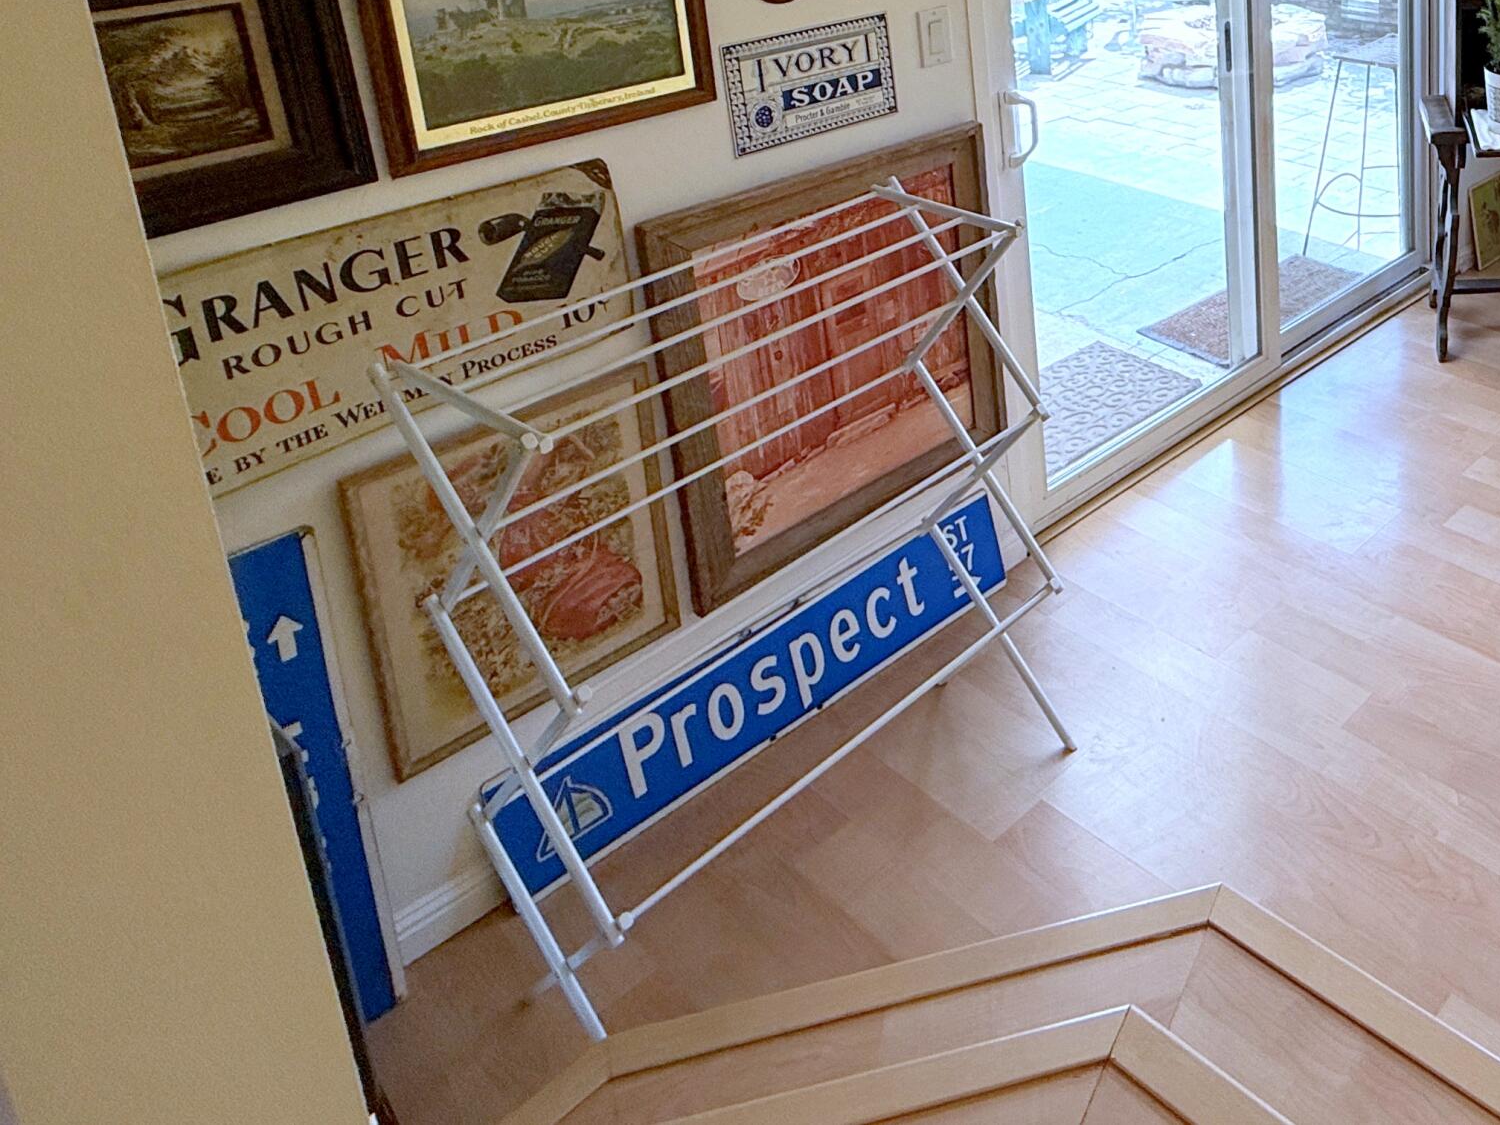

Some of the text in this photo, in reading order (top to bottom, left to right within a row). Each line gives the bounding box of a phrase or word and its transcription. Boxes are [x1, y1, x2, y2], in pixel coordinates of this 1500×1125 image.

[756, 37, 862, 92] IVORY
[790, 71, 874, 107] SOAP
[470, 124, 495, 135] Rock
[795, 111, 819, 124] Procter
[819, 109, 826, 117] &
[222, 278, 468, 380] ROUGH CUT
[234, 334, 558, 474] BY THE PROCESS
[942, 515, 968, 549] ST
[617, 557, 926, 800] Prospect
